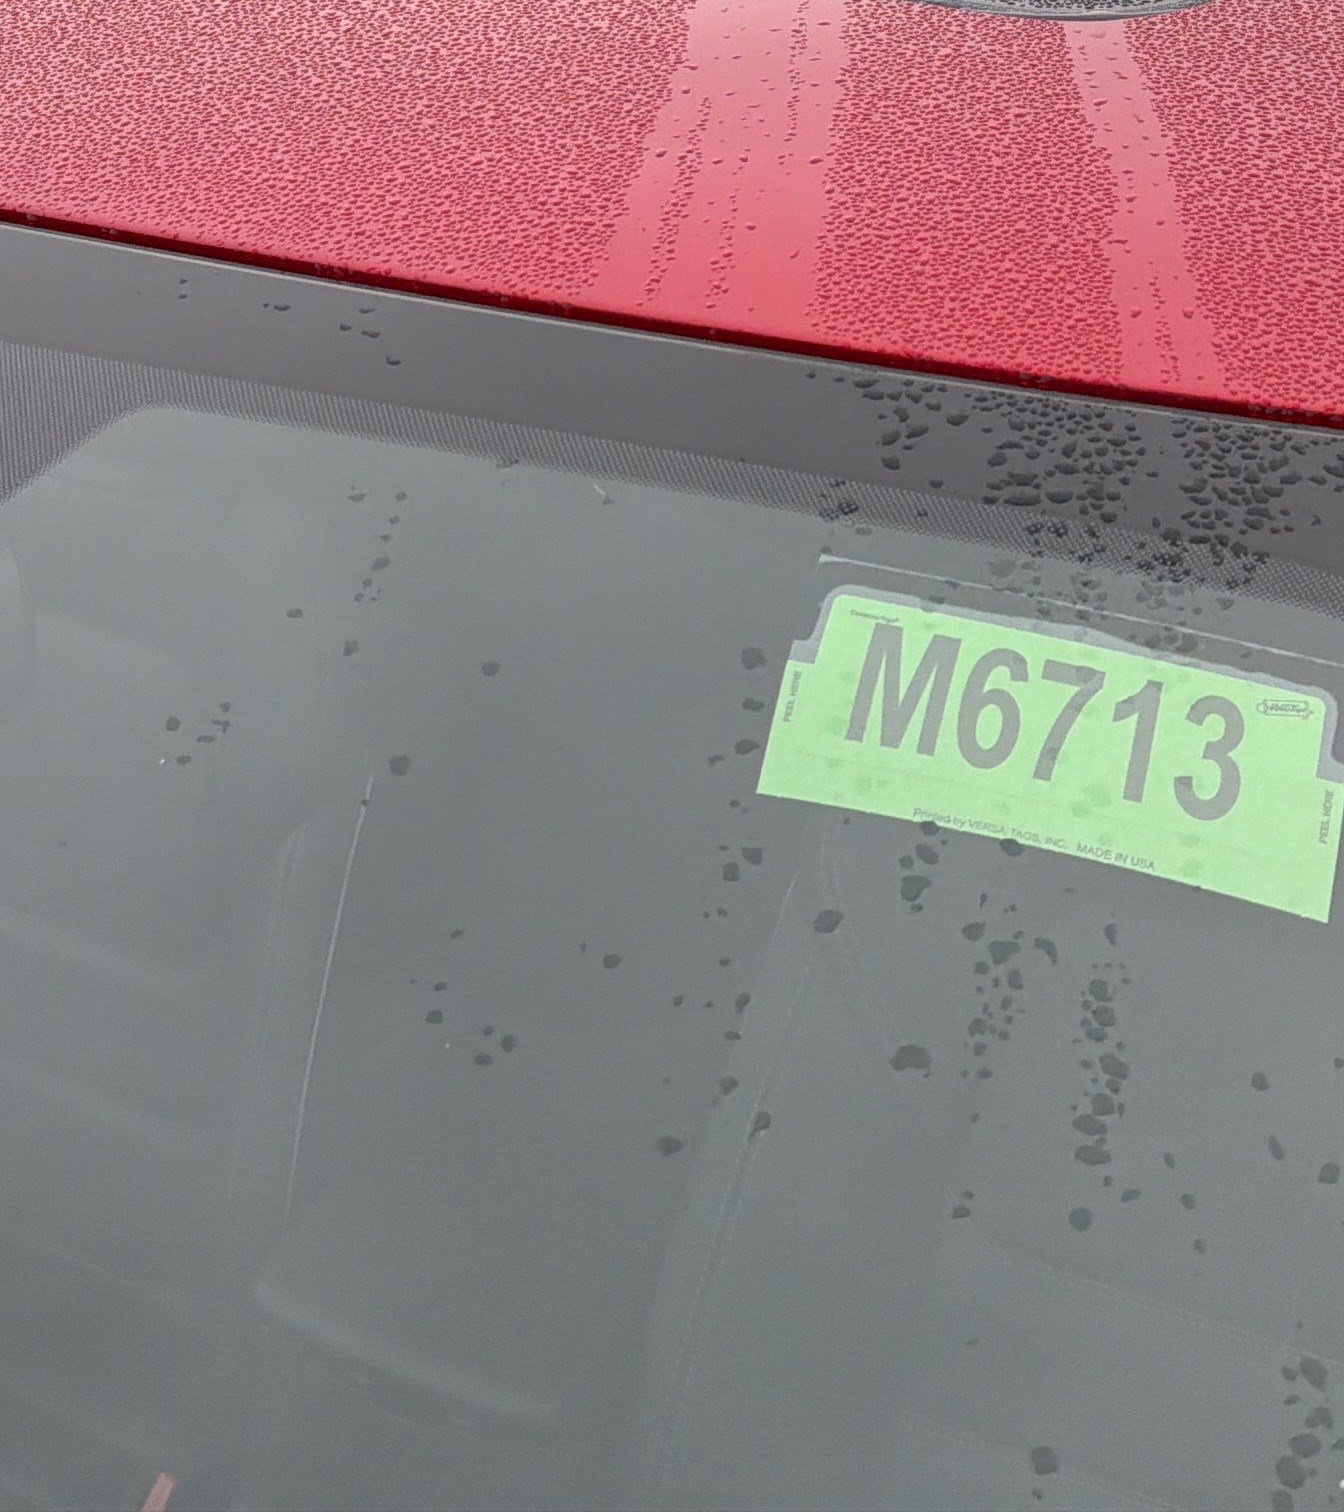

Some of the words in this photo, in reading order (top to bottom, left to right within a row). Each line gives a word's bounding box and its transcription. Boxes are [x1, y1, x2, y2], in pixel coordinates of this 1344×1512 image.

[844, 622, 1246, 822] M6713
[953, 816, 966, 828] by
[1076, 840, 1113, 860] MADE
[1114, 853, 1129, 865] IN
[1130, 855, 1156, 871] USA
